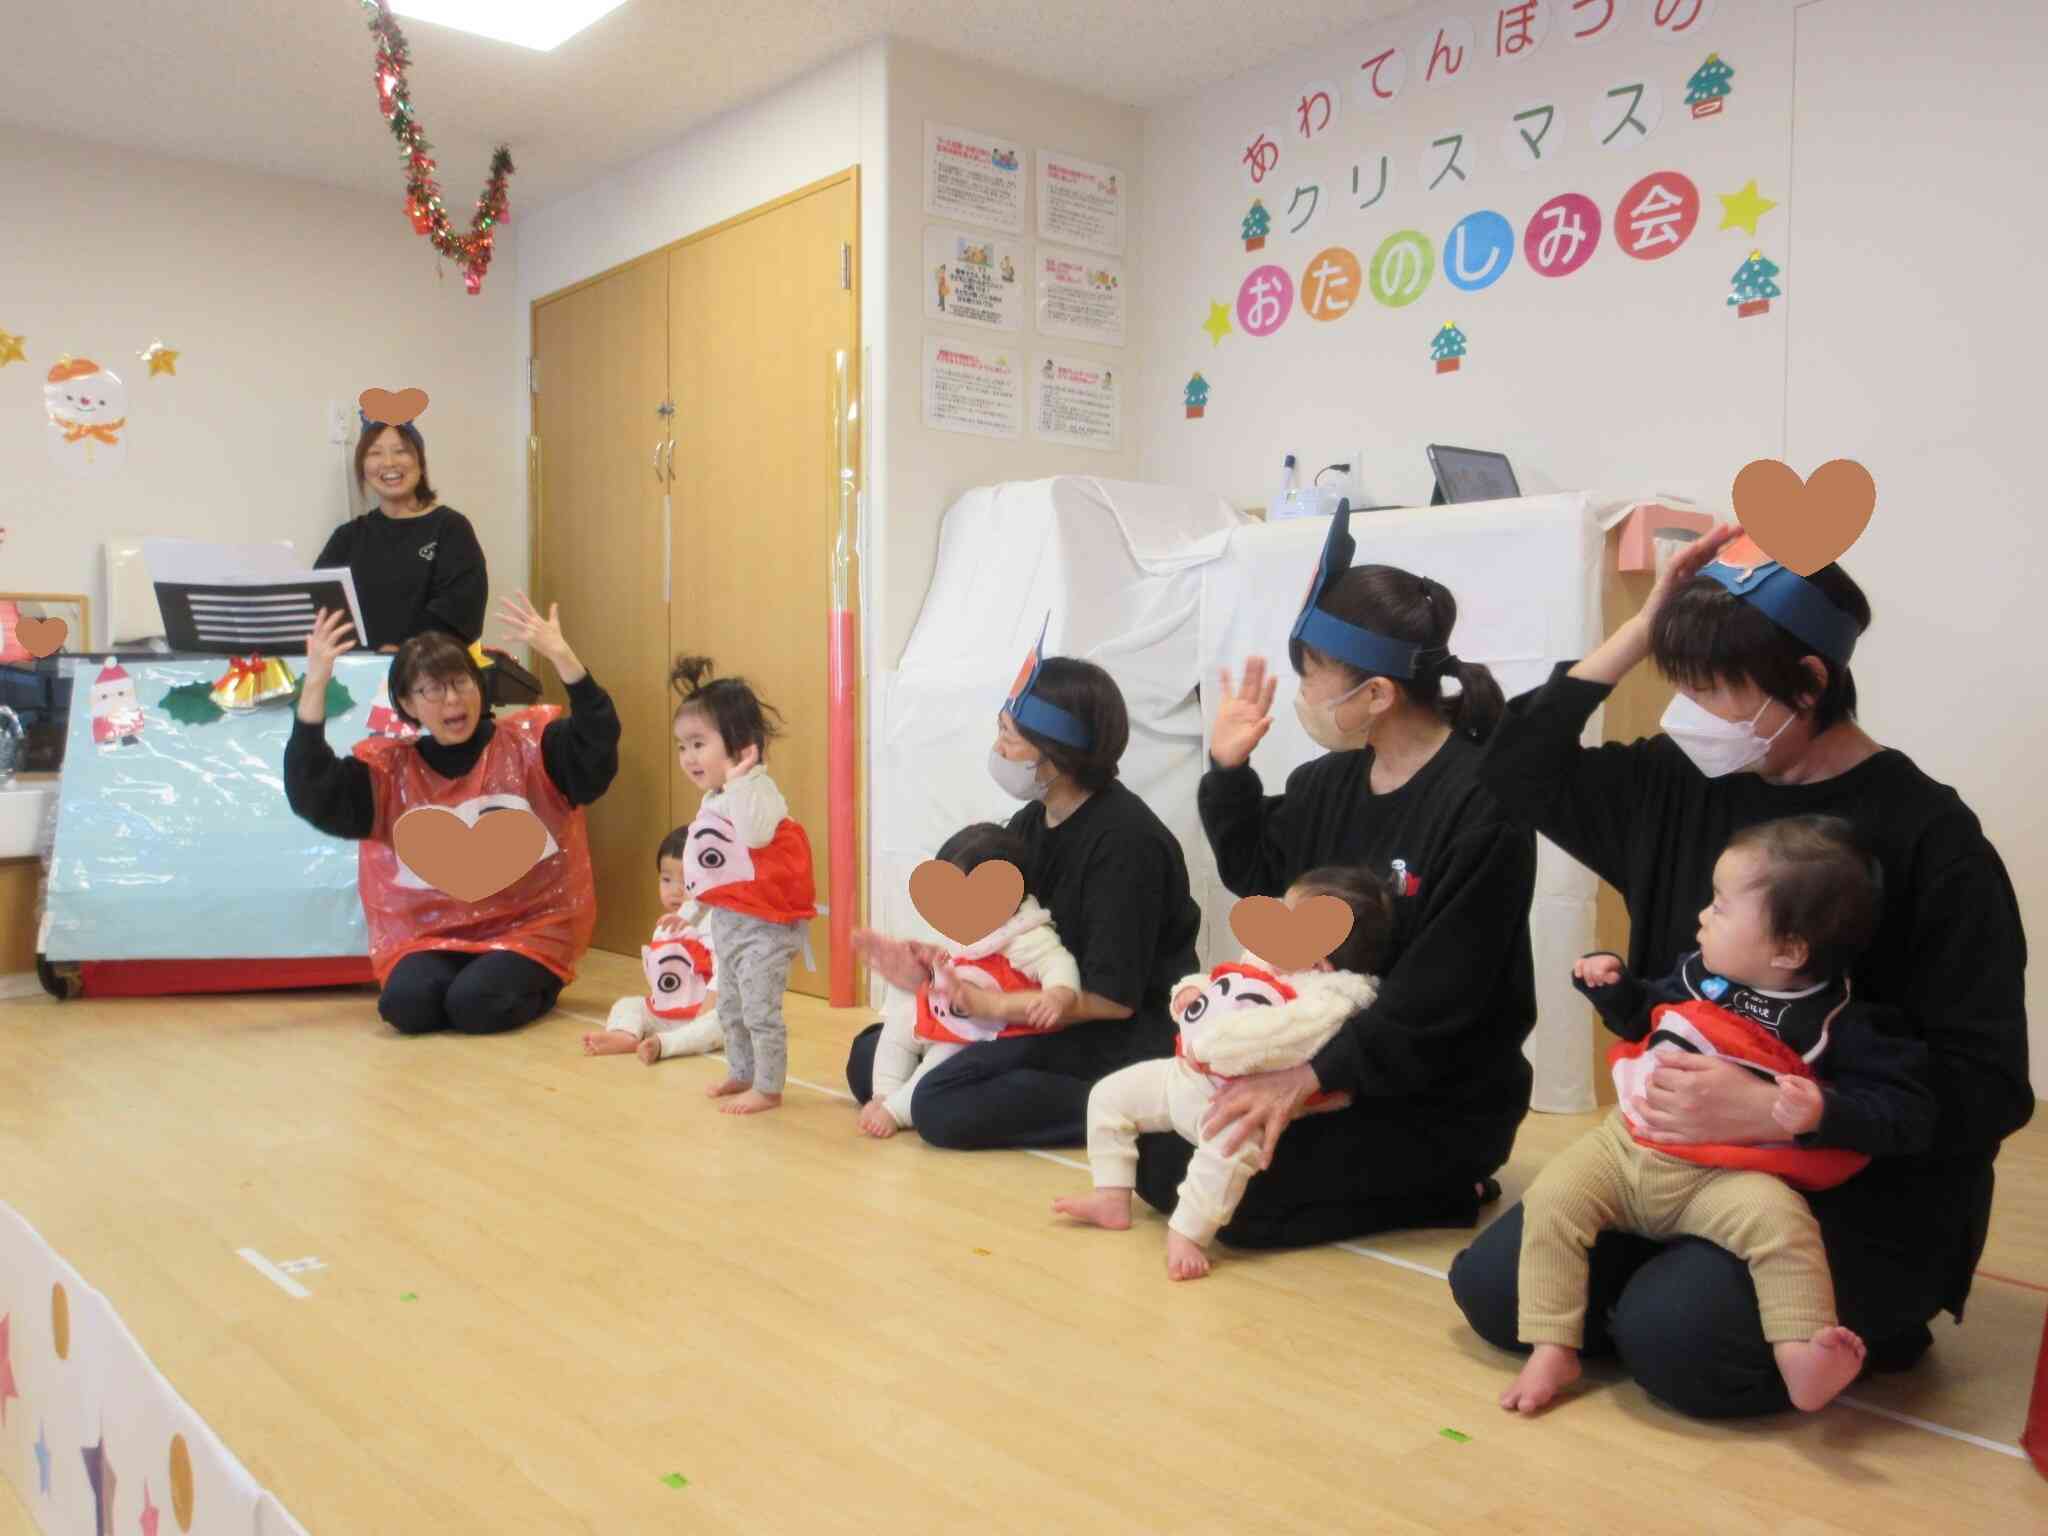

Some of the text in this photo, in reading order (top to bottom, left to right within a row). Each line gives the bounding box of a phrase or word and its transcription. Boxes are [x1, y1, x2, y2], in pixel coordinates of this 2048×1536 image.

[1286, 83, 1646, 233] クリスマス
[1245, 184, 1684, 330] おたのしみ会
